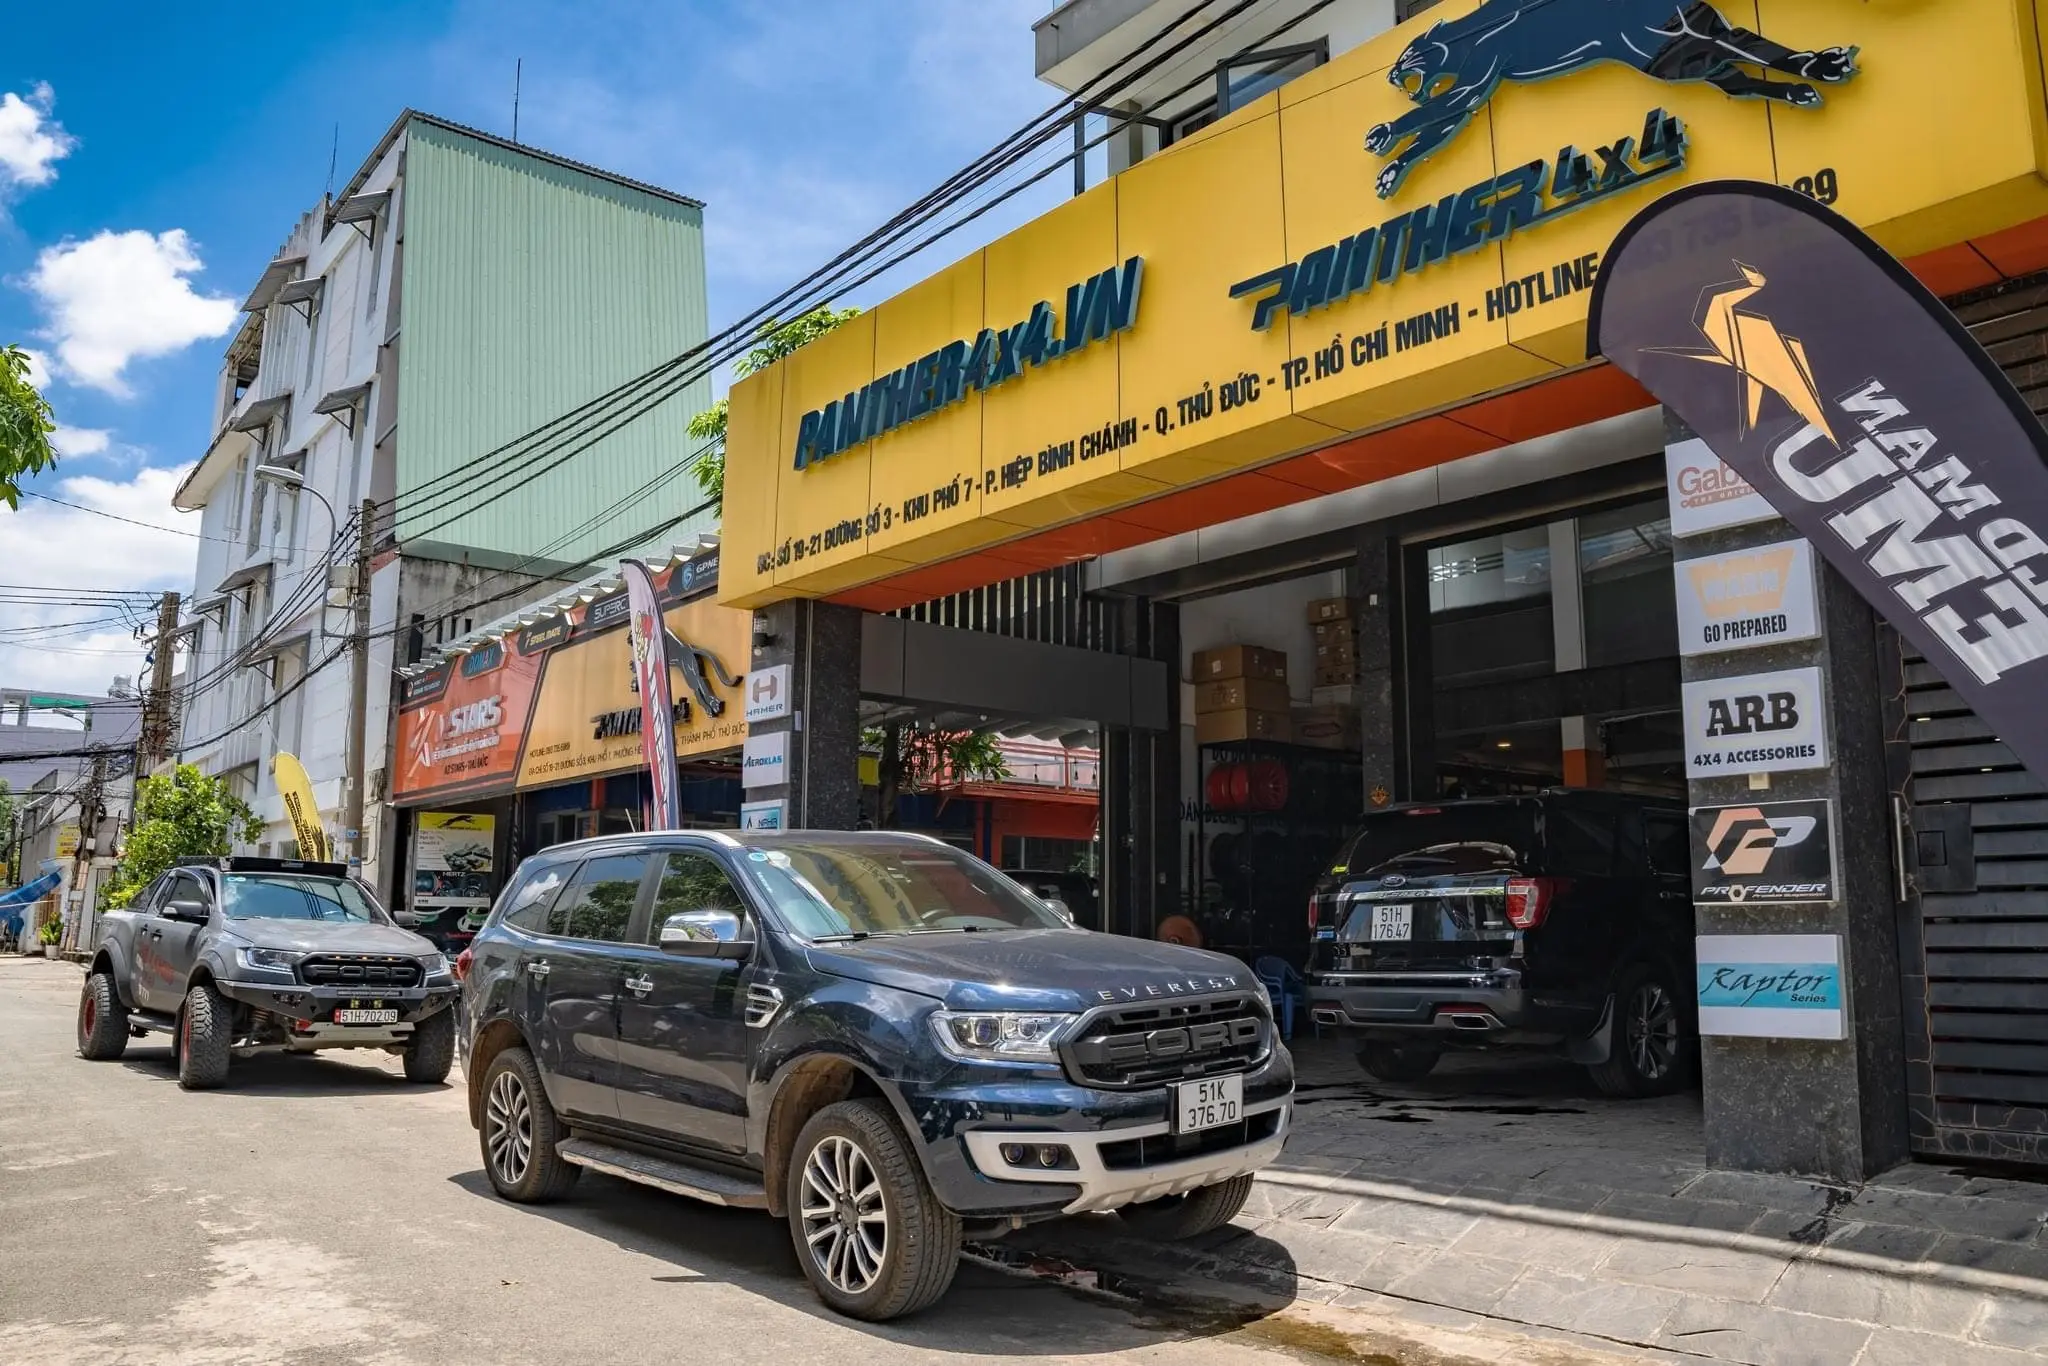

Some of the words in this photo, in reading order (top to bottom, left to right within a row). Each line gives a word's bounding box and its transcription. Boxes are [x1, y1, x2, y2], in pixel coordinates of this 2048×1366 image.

[794, 255, 1144, 471] PANTHER4x4.VN
[777, 537, 792, 567] SỐ
[794, 533, 821, 562] 19-21
[865, 503, 881, 536] SỐ
[883, 507, 892, 530] 3
[903, 493, 929, 523] KHU
[933, 473, 961, 513] PHỐ
[964, 478, 973, 501] 7
[985, 469, 998, 495] P.
[1001, 455, 1033, 489] HIỆP
[1038, 441, 1075, 476] BÌNH
[1080, 417, 1137, 460] CHÁNH
[1155, 406, 1175, 436] Q.
[1177, 381, 1213, 427] THỦ
[1219, 371, 1260, 412] ĐỨC
[1281, 357, 1311, 391] TP.
[1314, 333, 1344, 381] HỒ
[1351, 320, 1389, 367] CHÍ
[1395, 302, 1460, 353] MINH
[1677, 461, 1750, 496] Gab
[1704, 624, 1720, 644] GO
[1724, 614, 1787, 641] PREPARED
[746, 703, 783, 717] HAMER
[1706, 691, 1799, 737] ARB
[744, 755, 782, 768] AEROKLAS
[1693, 752, 1722, 767] 4X4
[1726, 744, 1816, 764] ACCESSORIES
[1701, 883, 1826, 901] PROFENDER
[1381, 907, 1402, 922] 51H
[1374, 923, 1410, 939] 176.47
[303, 964, 417, 979] FORD
[1097, 976, 1237, 1001] EVEREST
[1700, 967, 1831, 1007] Raptor
[1790, 993, 1827, 1003] Series
[1077, 1017, 1261, 1064] FORD
[1199, 1079, 1225, 1102] 51K
[1188, 1101, 1235, 1128] 376.70
